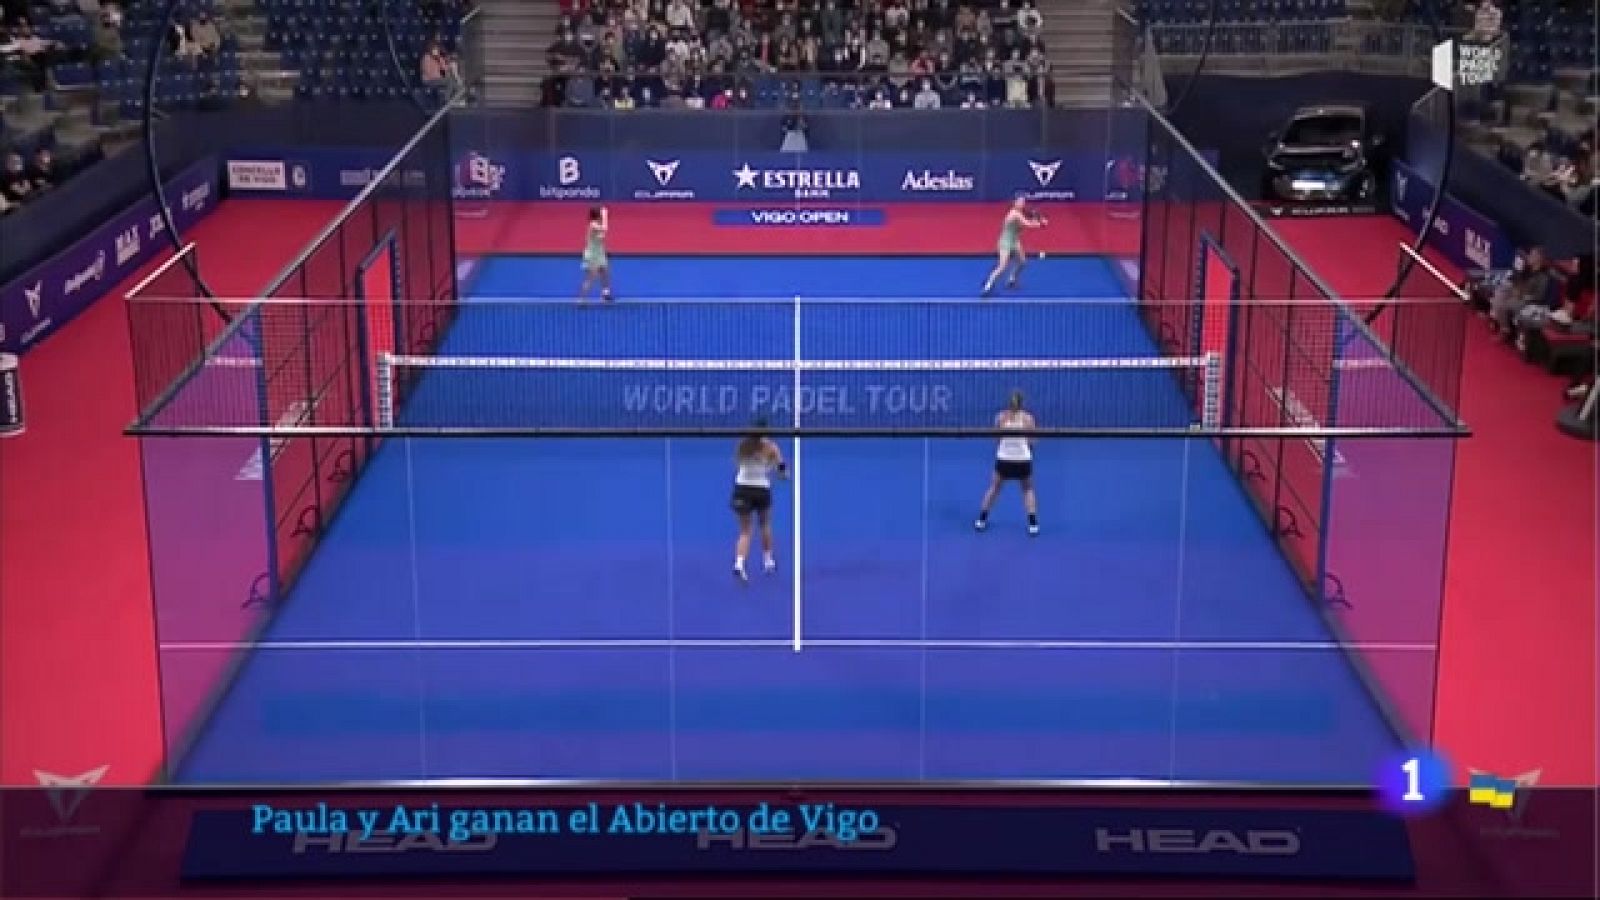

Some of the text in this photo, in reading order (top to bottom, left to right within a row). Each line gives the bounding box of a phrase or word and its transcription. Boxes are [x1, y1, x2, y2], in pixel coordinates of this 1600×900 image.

[764, 171, 860, 188] ESTRELLA
[902, 170, 974, 190] Adeslas
[540, 185, 600, 199] bitpanda
[751, 210, 848, 223] VIGO OPEN
[624, 384, 951, 416] WORLD PADEL TOUR
[697, 827, 897, 850] HEAD
[1095, 828, 1300, 855] HEAD
